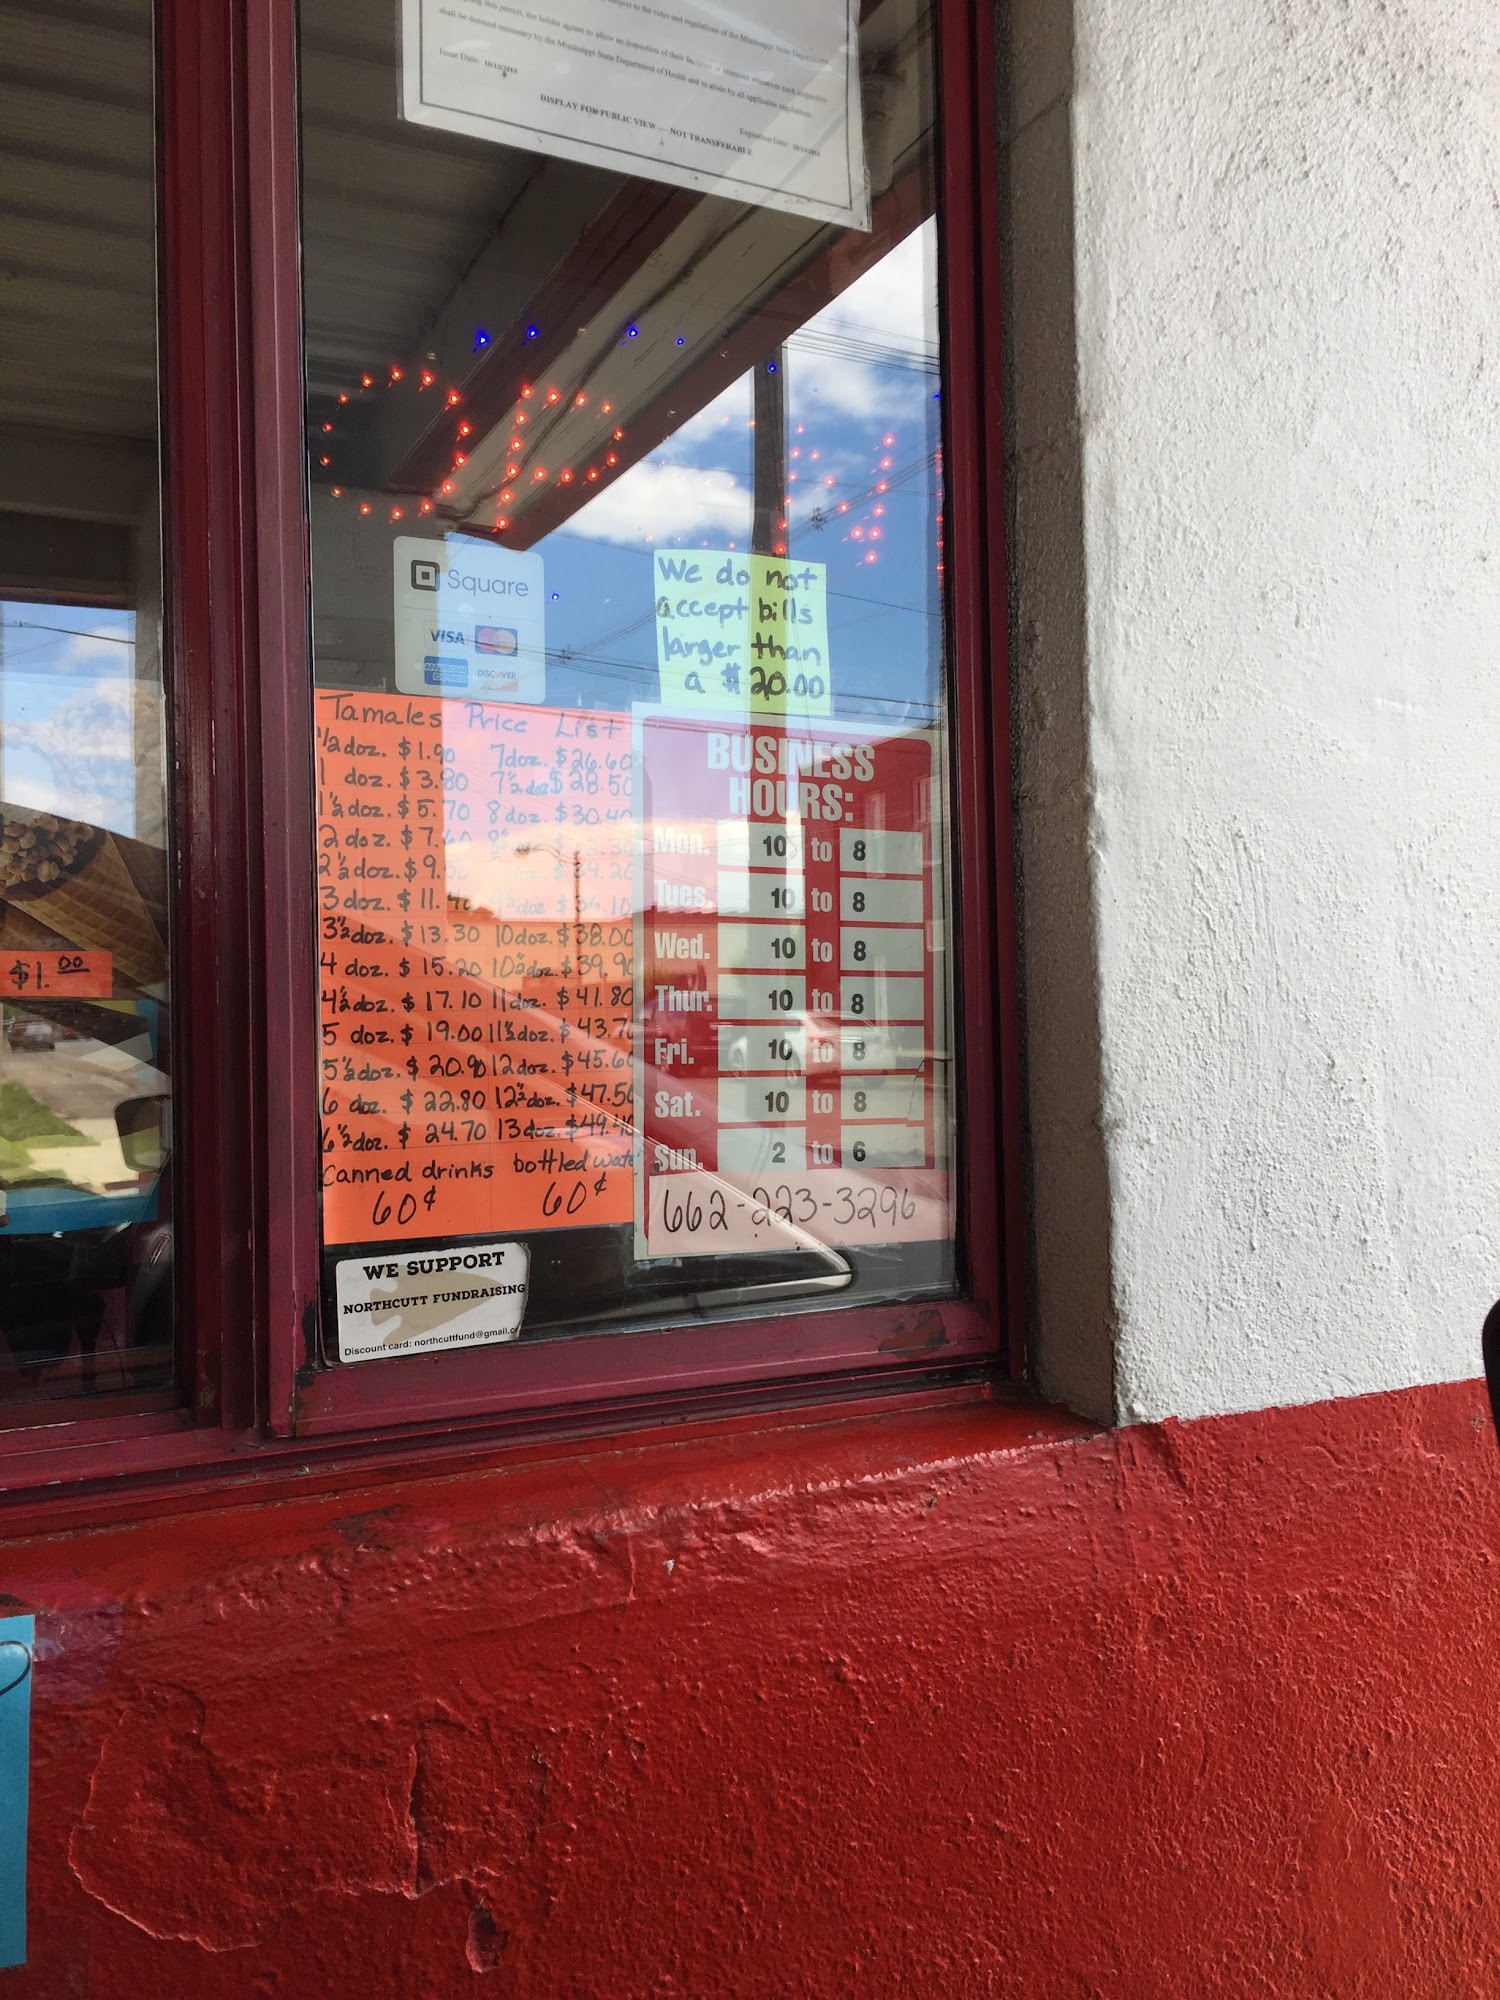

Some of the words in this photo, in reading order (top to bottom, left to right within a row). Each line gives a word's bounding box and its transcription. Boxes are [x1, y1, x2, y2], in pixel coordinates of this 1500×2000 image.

[497, 25, 532, 40] necessary
[533, 33, 543, 42] by
[544, 36, 556, 44] the
[556, 39, 596, 57] Mississippi
[596, 51, 614, 60] State
[615, 57, 654, 73] Department
[561, 23, 584, 34] agrees
[595, 31, 614, 41] allow
[625, 40, 660, 54] inspection
[539, 93, 578, 109] DISPLAY
[580, 104, 600, 115] FOR
[599, 109, 633, 123] PUBLIC
[632, 118, 656, 129] VIEW
[669, 128, 687, 138] NOT
[448, 569, 528, 597] Square
[658, 556, 702, 583] We
[716, 558, 749, 586] do
[766, 568, 818, 591] not
[656, 596, 749, 628] accept
[759, 597, 813, 624] bills
[430, 629, 465, 644] VISA
[662, 626, 740, 666] larger
[751, 632, 822, 666] than
[684, 671, 706, 693] a
[320, 693, 441, 726] Tamales
[465, 703, 528, 734] Price
[556, 711, 623, 738] List
[707, 731, 875, 782] BUSINESS
[345, 768, 391, 788] doz.
[729, 777, 854, 822] HOURS:
[345, 828, 391, 848] doz.
[653, 825, 710, 855] Mon.
[763, 835, 787, 857] 10
[810, 837, 833, 863] to
[852, 840, 866, 862] 8
[654, 879, 713, 908] Tues.
[771, 888, 796, 909] 10
[810, 887, 833, 913] to
[852, 891, 866, 913] 8
[654, 932, 710, 960] Wed.
[771, 937, 796, 959] 10
[811, 937, 833, 963] to
[853, 940, 867, 961] 8
[345, 954, 389, 978] doz.
[654, 985, 712, 1013] Thur.
[768, 989, 793, 1011] 10
[812, 988, 833, 1013] to
[851, 993, 864, 1014] 8
[350, 1025, 395, 1045] doz.
[654, 1038, 695, 1065] Fri.
[768, 1039, 793, 1061] 10
[812, 1039, 833, 1064] to
[853, 1040, 866, 1061] 8
[349, 1093, 387, 1115] doz.
[654, 1091, 701, 1118] Sat.
[765, 1091, 790, 1113] 10
[812, 1089, 833, 1114] to
[854, 1091, 867, 1112] 8
[323, 1162, 412, 1187] Canned
[422, 1157, 495, 1180] drinks
[514, 1149, 589, 1175] bottled
[654, 1143, 704, 1172] Sun.
[772, 1142, 786, 1163] 2
[812, 1141, 833, 1165] to
[853, 1140, 866, 1162] 6
[663, 1185, 917, 1234] 662-223-3296
[363, 1263, 399, 1280] WE
[407, 1251, 505, 1276] SUPPORT
[343, 1296, 428, 1314] NORTHCUTT
[433, 1284, 526, 1304] FUNDRAISING
[345, 1344, 386, 1356] Discount
[389, 1341, 412, 1351] card:
